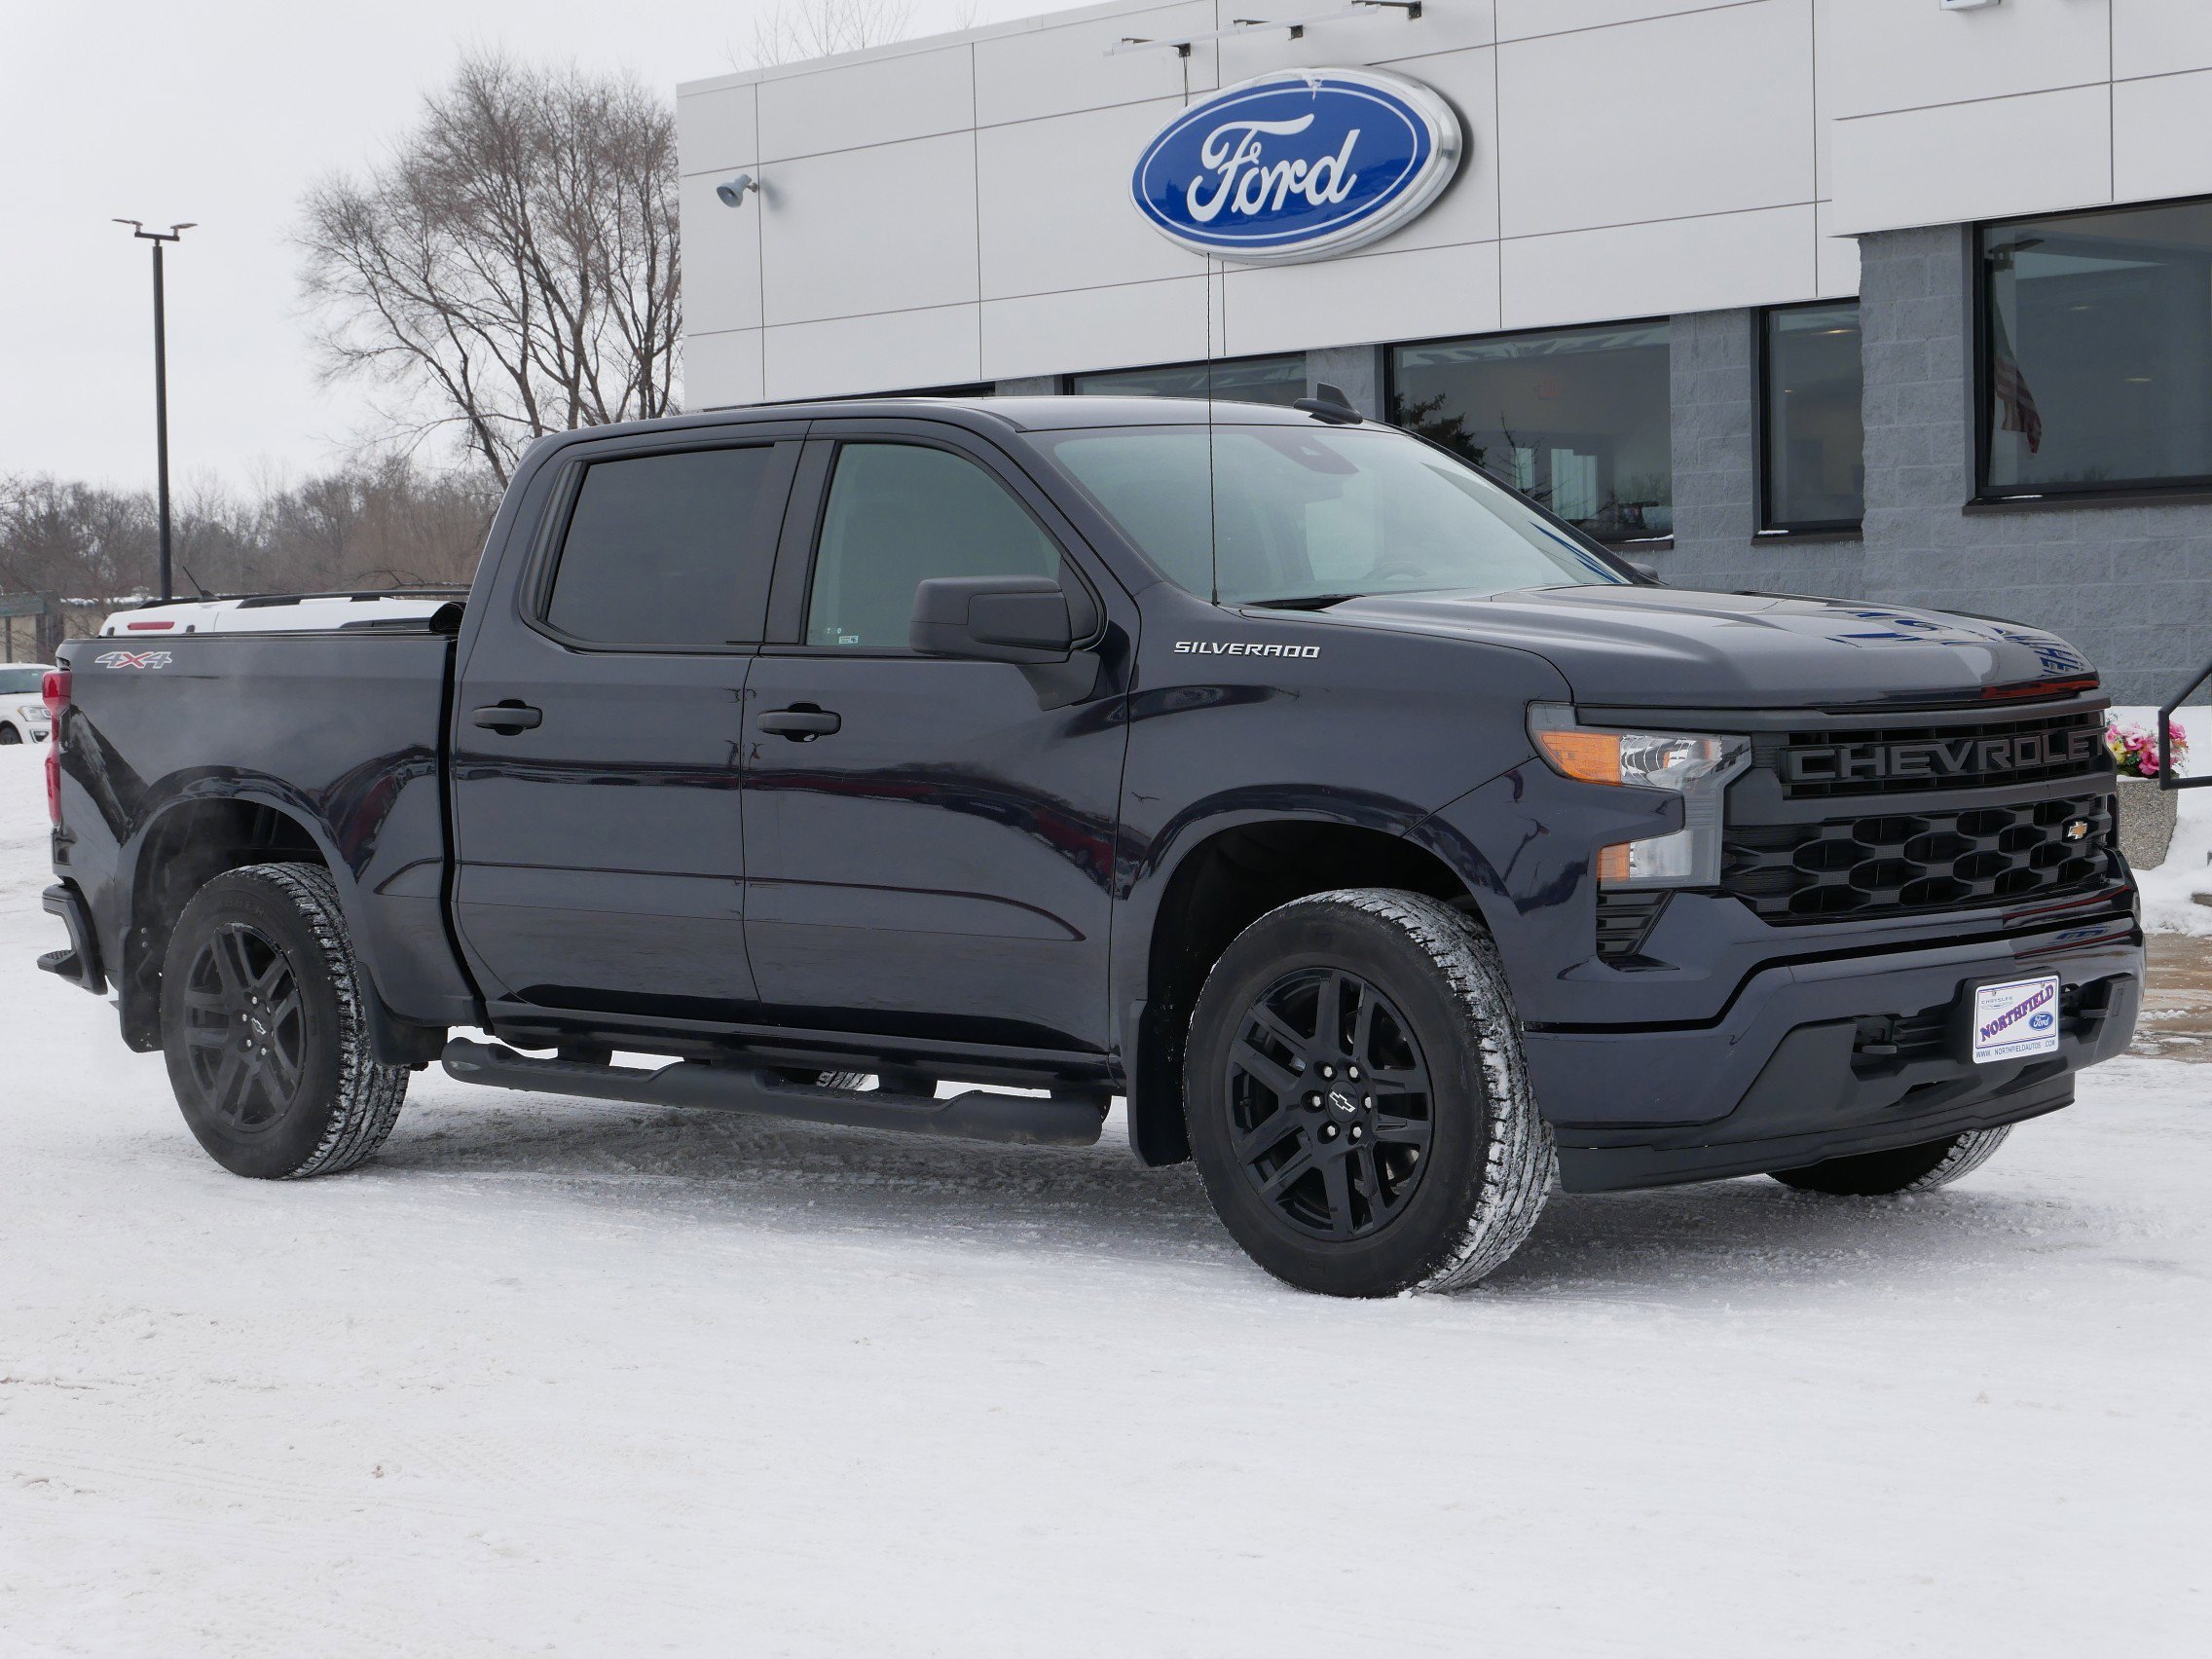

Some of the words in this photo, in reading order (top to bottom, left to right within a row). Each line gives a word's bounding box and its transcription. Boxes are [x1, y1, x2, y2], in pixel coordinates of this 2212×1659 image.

[1187, 113, 1360, 222] Ford
[1173, 641, 1321, 659] SILVERADO
[1979, 984, 2054, 1043] NORTHFIELD
[2033, 1014, 2050, 1027] Ford
